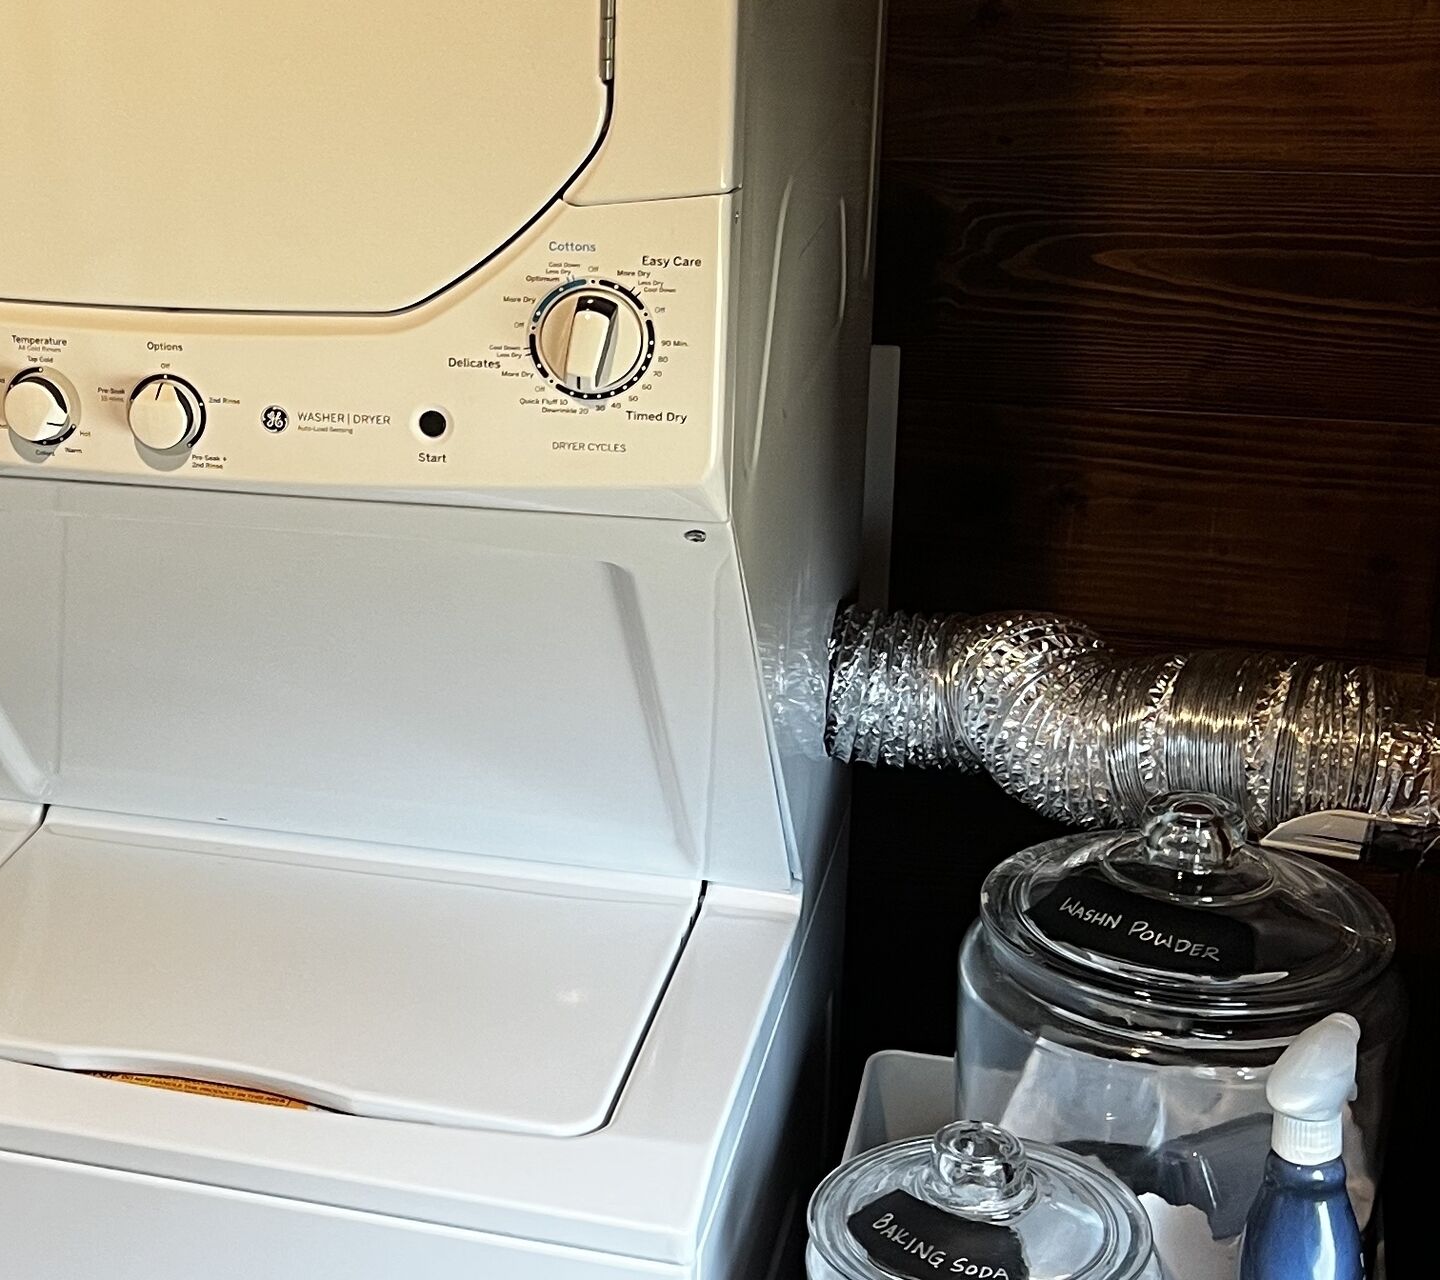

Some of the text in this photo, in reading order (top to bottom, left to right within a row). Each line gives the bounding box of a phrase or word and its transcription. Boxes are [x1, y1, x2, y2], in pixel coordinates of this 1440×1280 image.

[548, 240, 596, 252] Cottons
[642, 255, 702, 268] Easy Care
[637, 270, 651, 278] Dry
[523, 296, 537, 304] Dry
[513, 321, 525, 329] Off
[11, 334, 68, 347] Temperature
[146, 341, 184, 352] Options
[448, 357, 501, 369] Delicates
[521, 371, 535, 379] Dry
[641, 383, 653, 391] 60
[297, 411, 392, 426] WASHER DRYER
[625, 410, 688, 425] Timed Dry
[552, 441, 626, 453] DRYER CYCLES
[418, 452, 447, 463] Start
[1058, 896, 1221, 963] WASHN POWDER
[872, 1212, 947, 1269] BAKING
